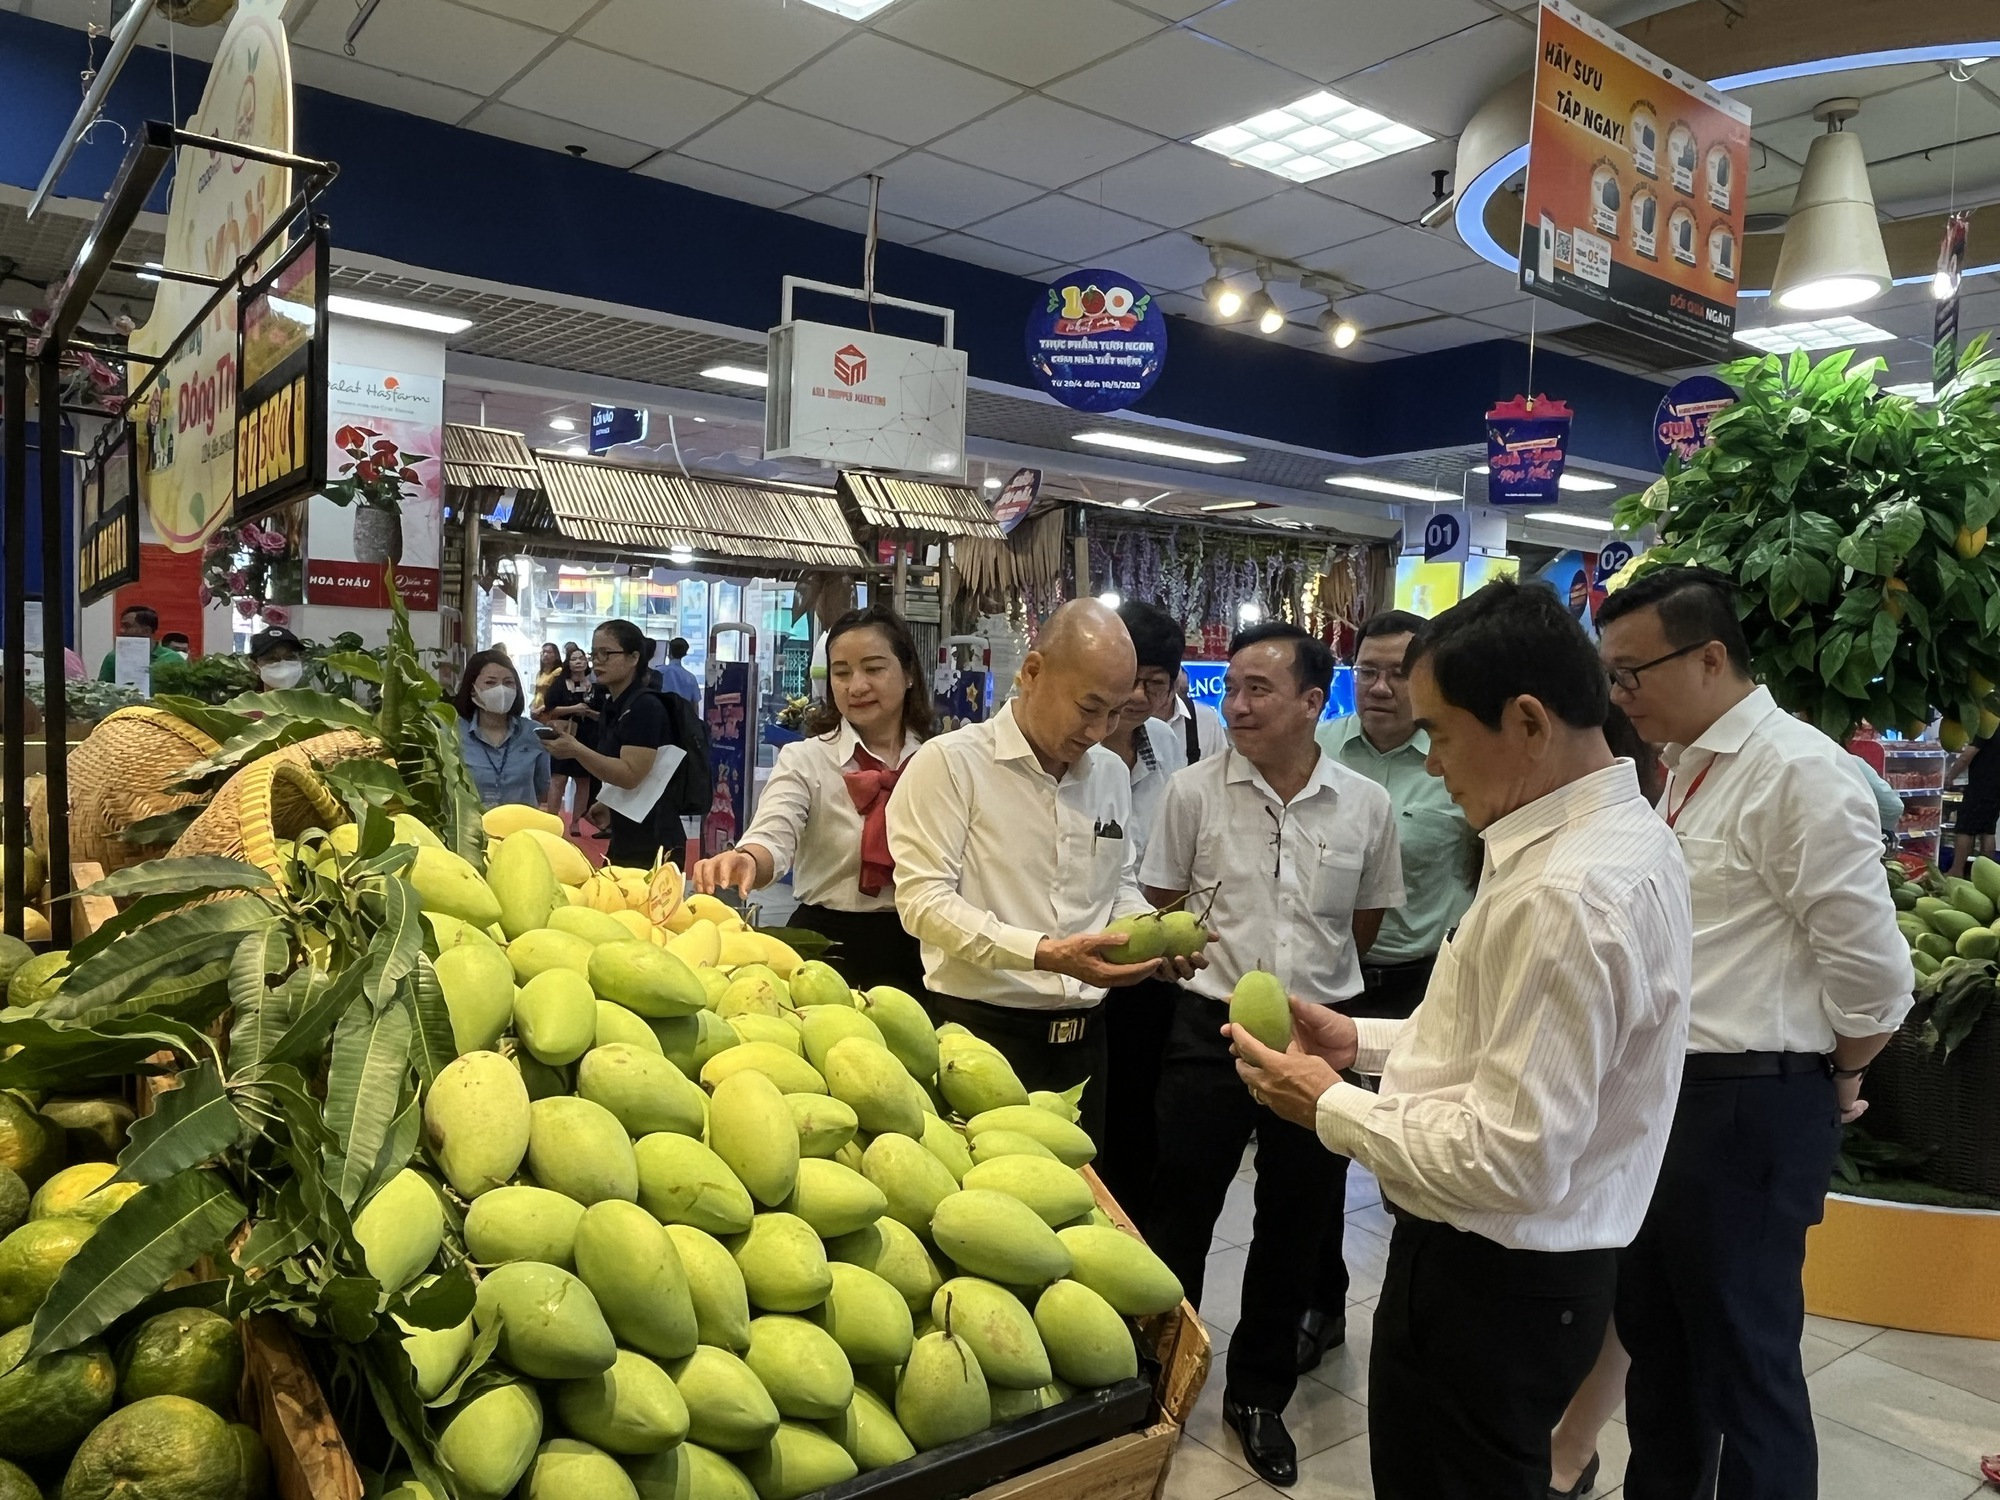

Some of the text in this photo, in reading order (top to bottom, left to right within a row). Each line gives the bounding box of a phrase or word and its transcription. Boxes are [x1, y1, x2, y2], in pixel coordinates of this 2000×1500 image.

[1545, 41, 1572, 74] HÃY
[1573, 58, 1603, 92] SƯU
[1556, 90, 1625, 145] TẬP NGAY!
[1588, 249, 1599, 265] 05
[1061, 284, 1134, 319] 100
[1705, 307, 1731, 328] NGAY!
[1124, 342, 1155, 353] NGON
[328, 380, 362, 393] alat
[1427, 523, 1454, 547] 01
[1600, 549, 1629, 571] 02
[309, 575, 335, 586] HOA
